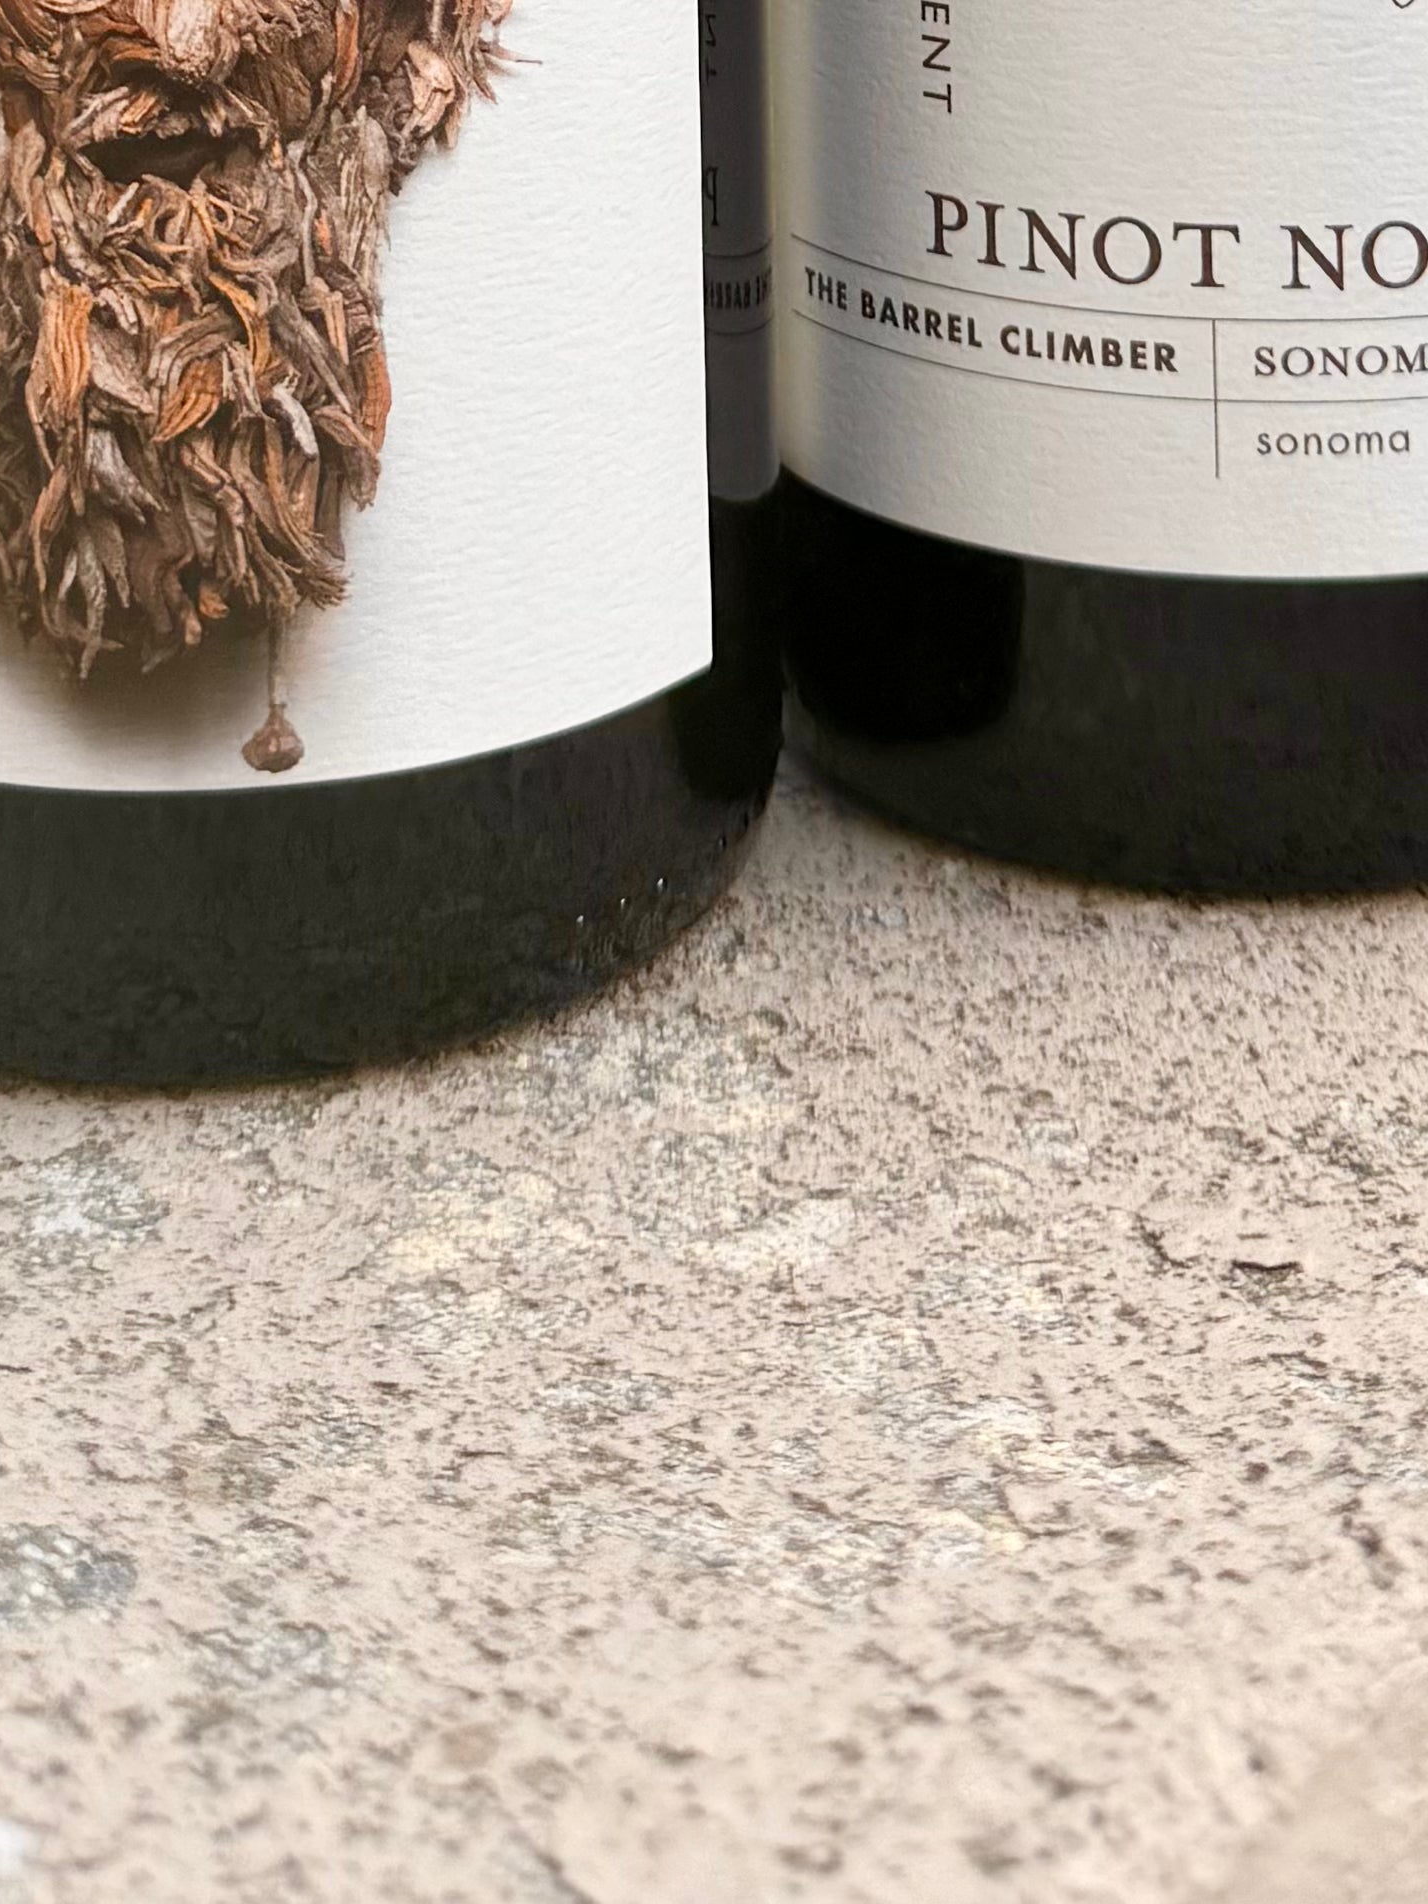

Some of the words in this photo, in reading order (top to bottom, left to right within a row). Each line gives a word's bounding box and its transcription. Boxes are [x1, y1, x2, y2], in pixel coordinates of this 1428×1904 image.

[924, 189, 1241, 288] PINOT
[805, 267, 848, 312] THE
[860, 288, 983, 350] BARREL
[999, 324, 1178, 375] CLIMBER
[1256, 427, 1411, 457] sonoma
